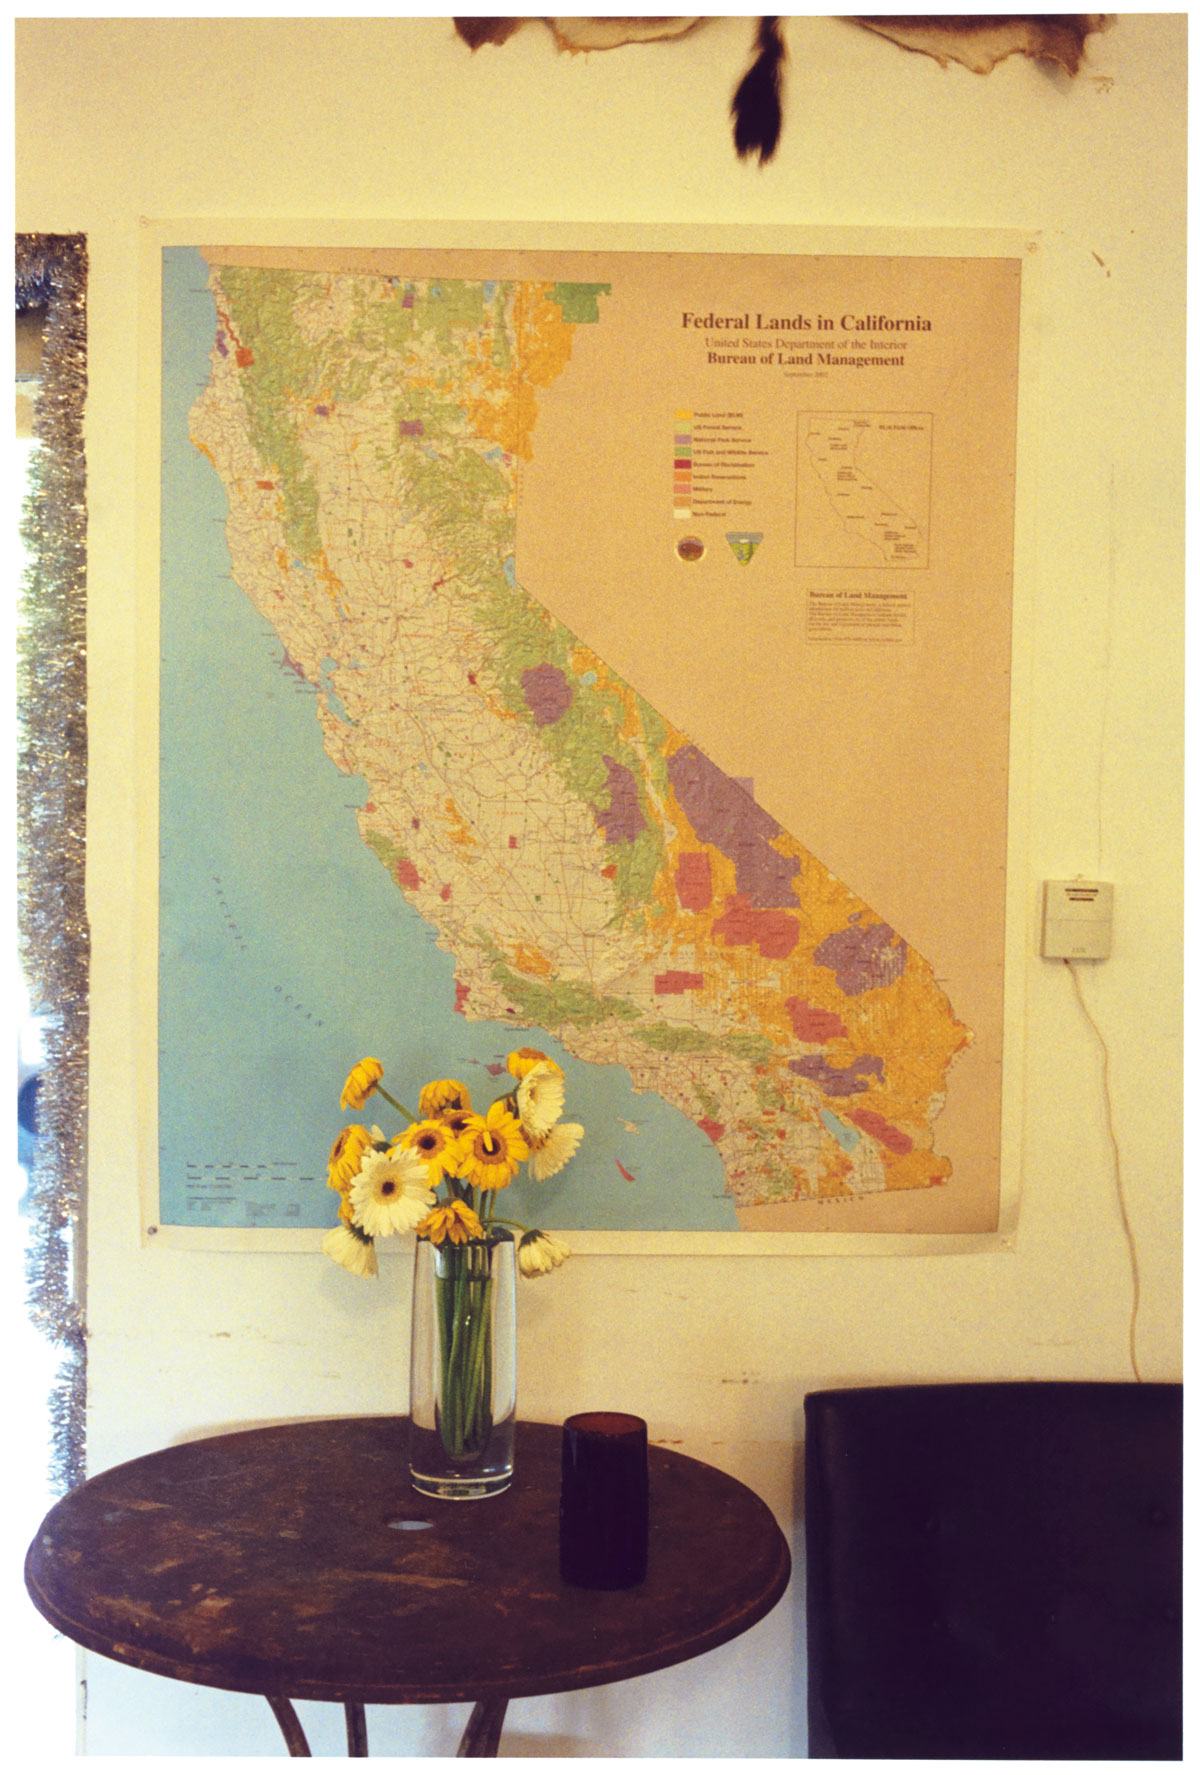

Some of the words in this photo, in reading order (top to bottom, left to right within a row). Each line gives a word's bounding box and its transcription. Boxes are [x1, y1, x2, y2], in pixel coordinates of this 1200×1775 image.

[681, 311, 750, 330] Federal
[756, 312, 812, 331] Lands
[817, 313, 835, 331] in
[840, 314, 932, 332] California
[704, 337, 740, 349] United
[742, 338, 773, 349] States
[775, 338, 836, 351] Department
[837, 339, 848, 350] of
[851, 339, 867, 350] the
[869, 340, 908, 351] Interior
[707, 351, 757, 365] Bureau
[759, 351, 775, 365] of
[777, 352, 814, 366] Land
[817, 353, 905, 369] Management
